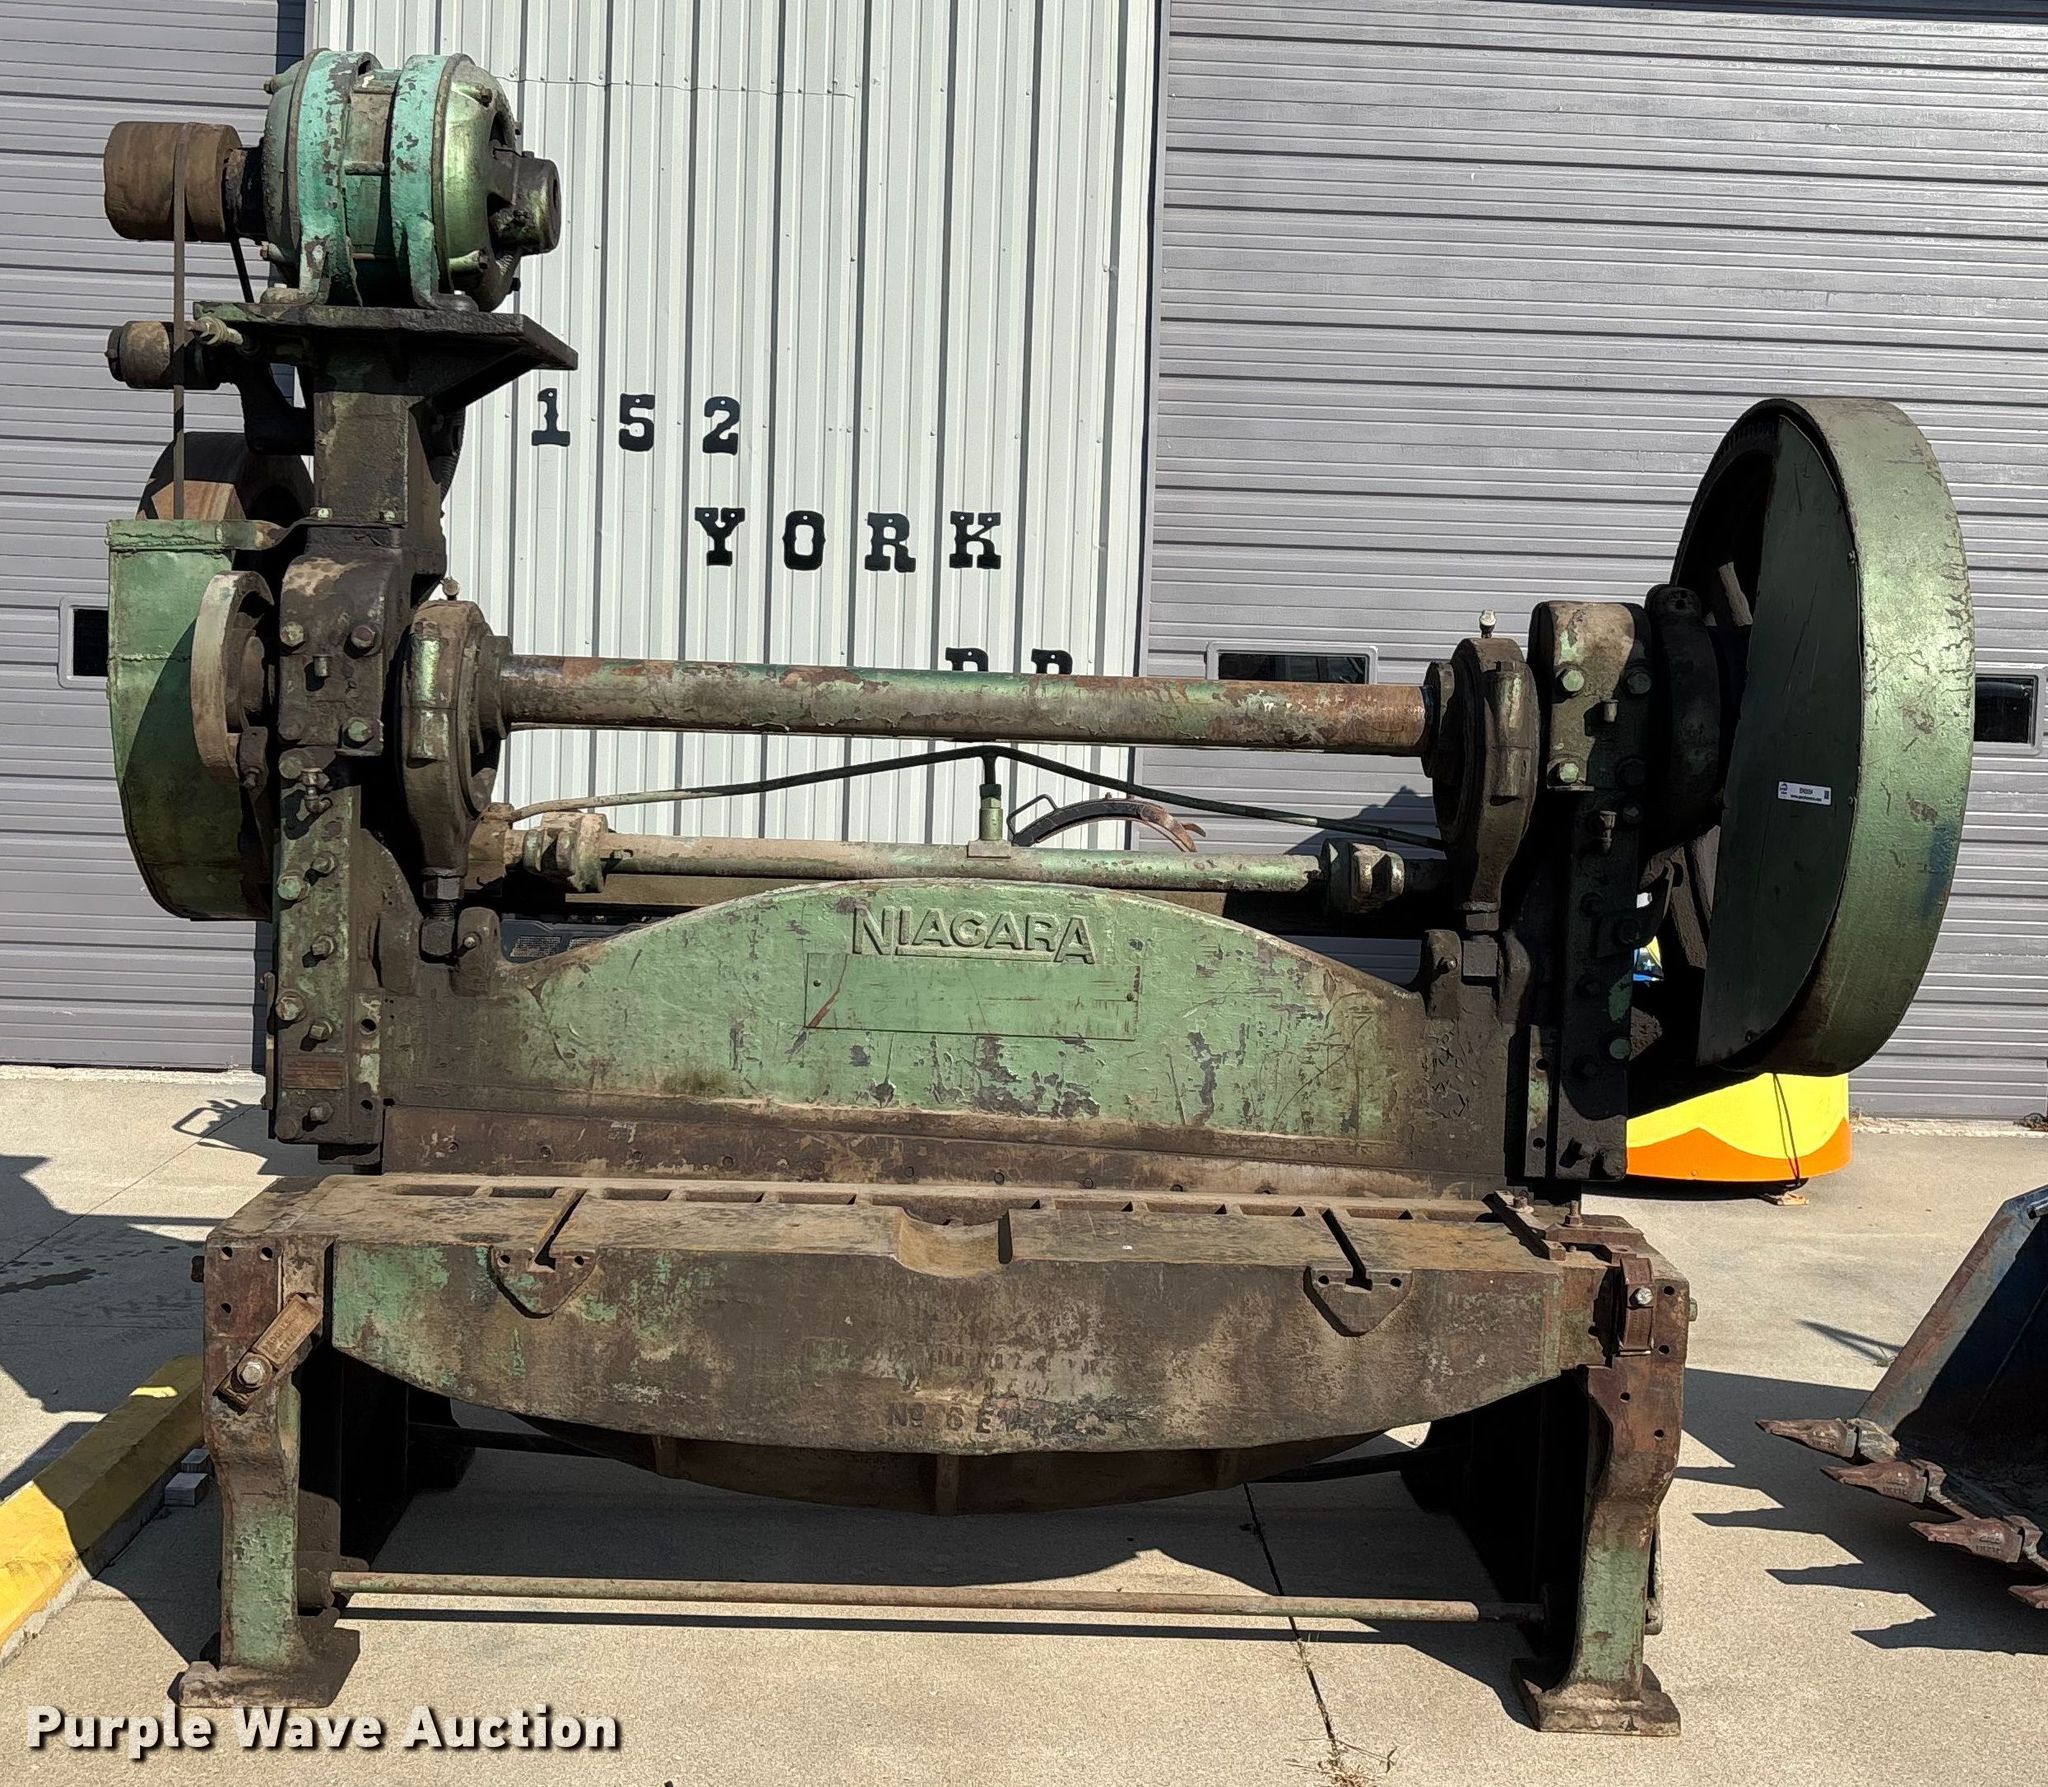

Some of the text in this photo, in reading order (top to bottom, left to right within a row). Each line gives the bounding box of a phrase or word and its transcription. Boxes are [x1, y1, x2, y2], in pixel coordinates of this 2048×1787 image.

[531, 387, 741, 455] 152
[694, 507, 1002, 573] YORK
[852, 904, 1096, 965] NIAGARA
